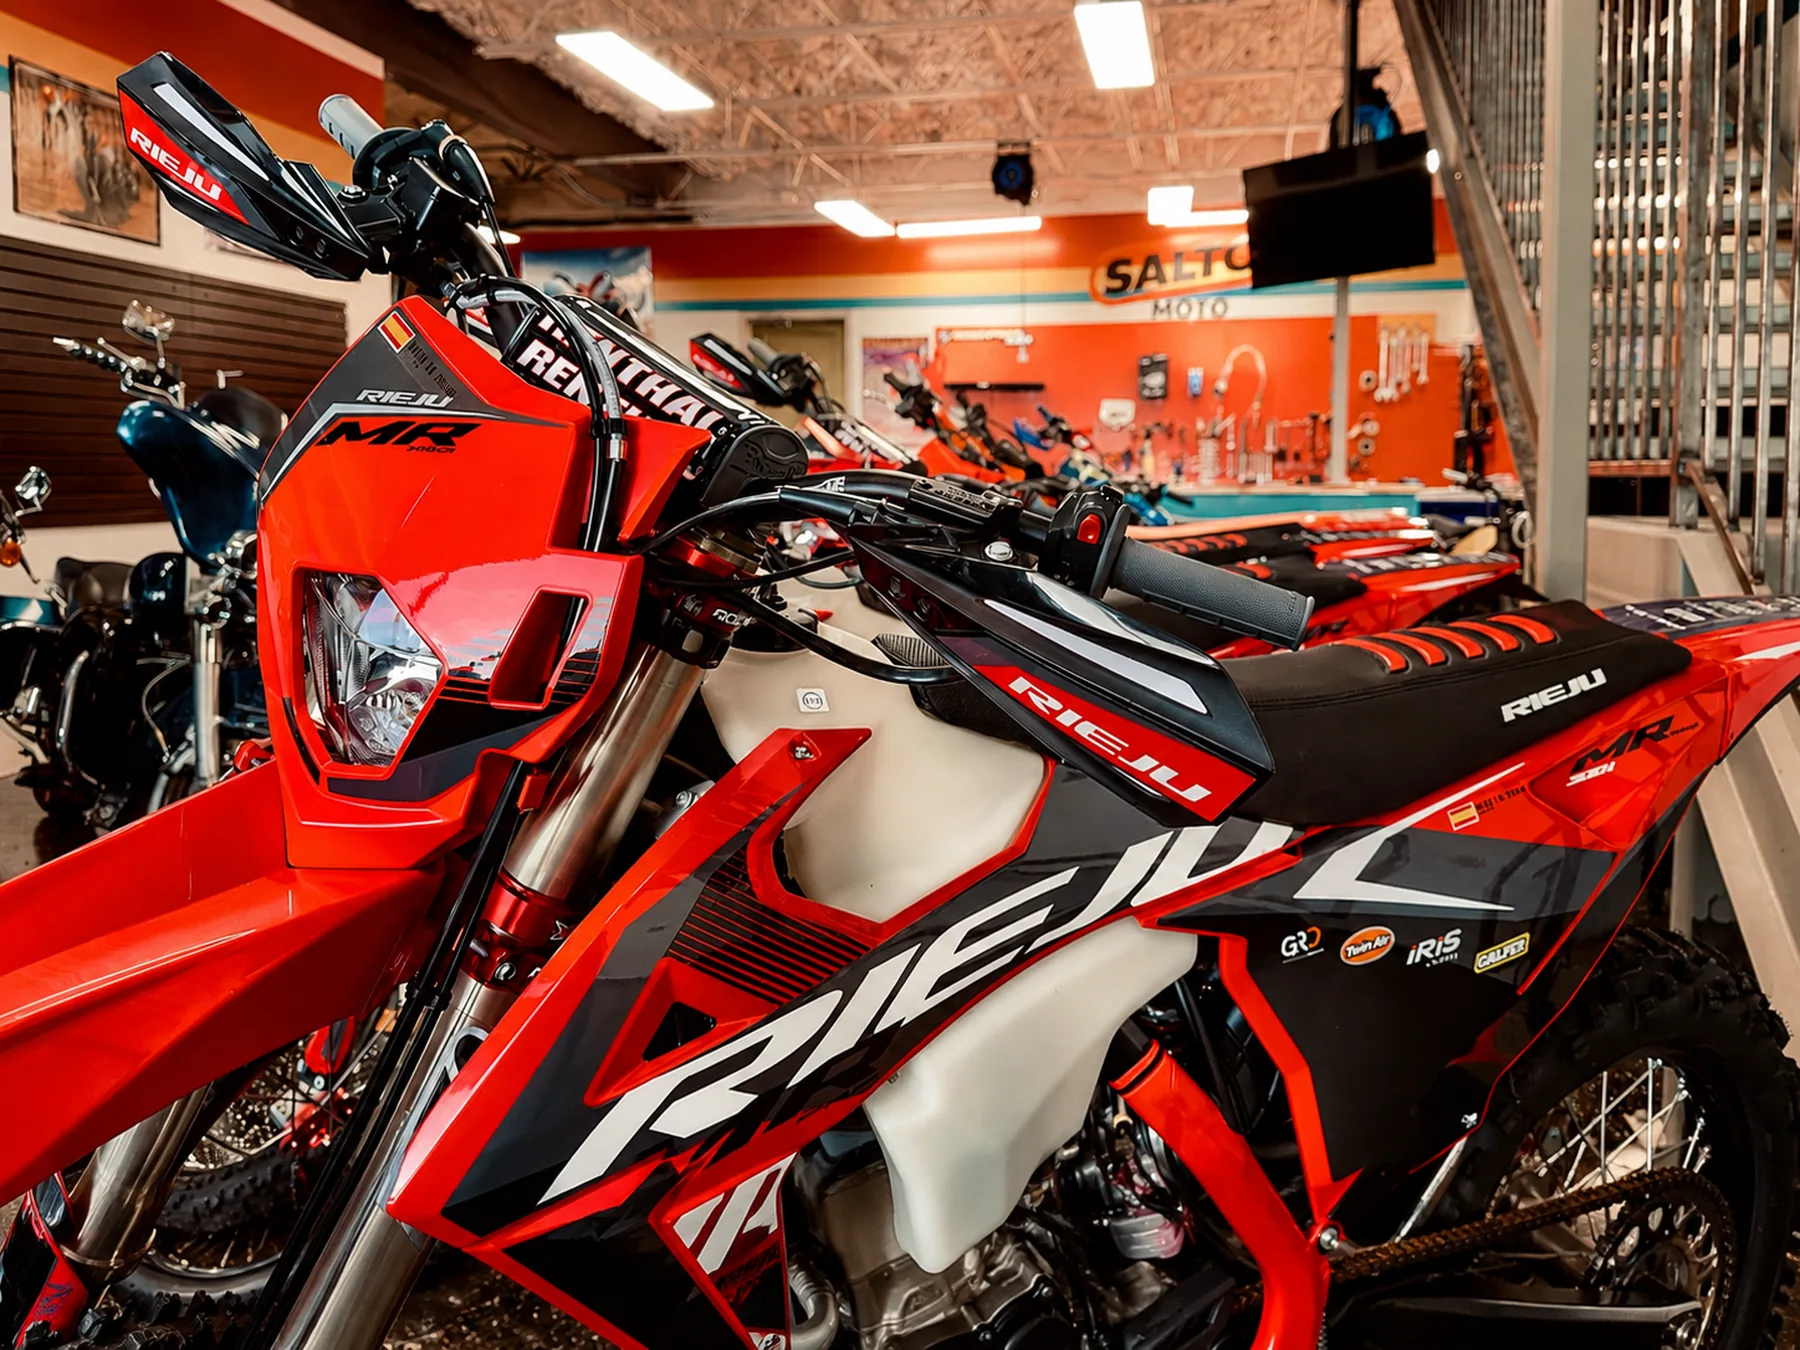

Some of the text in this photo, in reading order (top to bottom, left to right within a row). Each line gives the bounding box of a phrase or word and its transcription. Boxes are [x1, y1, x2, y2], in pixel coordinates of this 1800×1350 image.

[130, 127, 221, 200] RIEJU
[1105, 244, 1251, 294] SALTO
[1152, 296, 1228, 320] MOTO
[356, 389, 454, 408] RIEJU
[315, 421, 482, 446] MR
[1501, 667, 1607, 723] RIEJU
[1008, 676, 1212, 801] RIEJU
[1570, 715, 1674, 775] MR
[1345, 939, 1374, 958] Twin
[1477, 938, 1526, 969] GALFER
[537, 822, 1292, 1206] RIEJU
